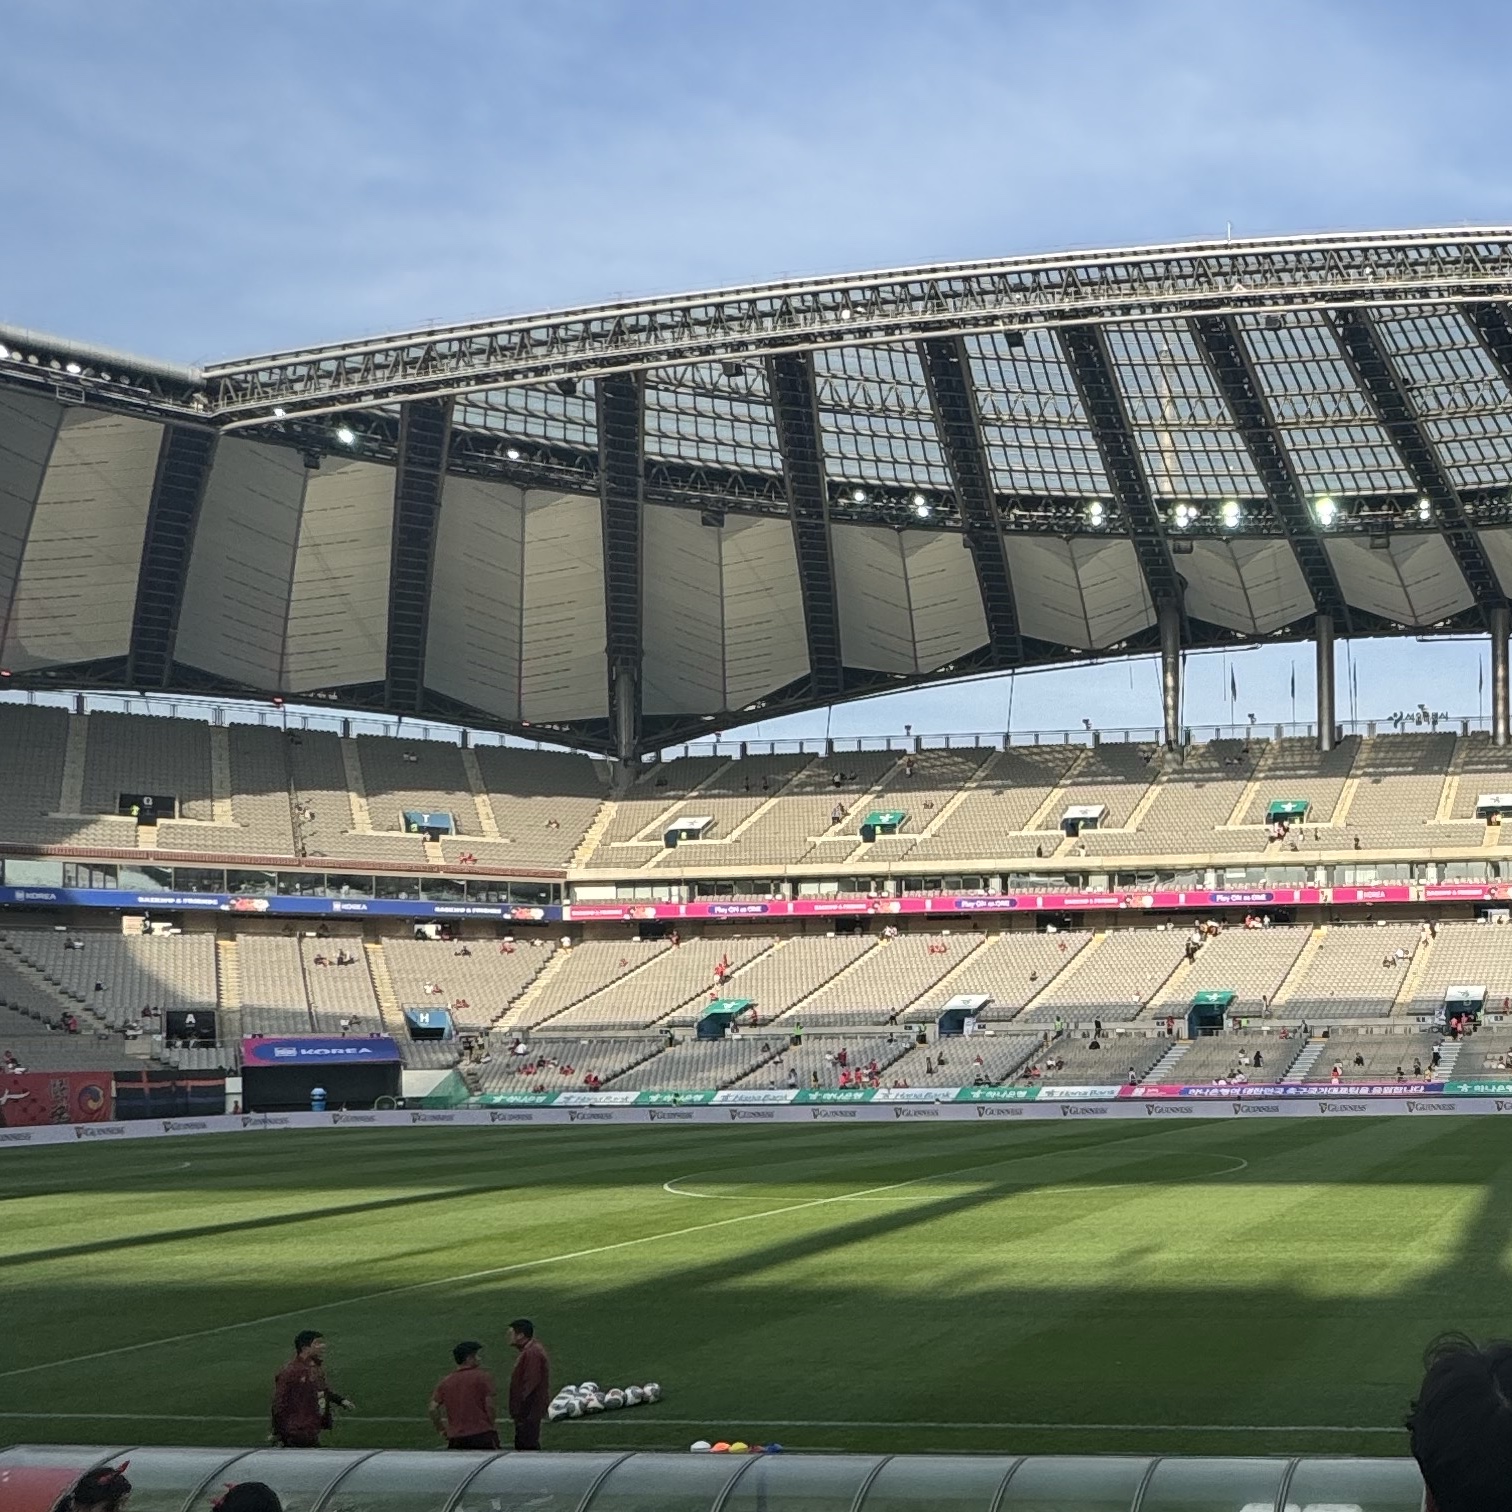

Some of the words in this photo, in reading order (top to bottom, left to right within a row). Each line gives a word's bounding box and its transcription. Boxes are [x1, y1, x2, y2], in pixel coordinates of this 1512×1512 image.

[422, 814, 430, 824] T
[185, 1013, 196, 1024] A
[419, 1013, 430, 1023] H
[301, 1047, 373, 1055] KOREA
